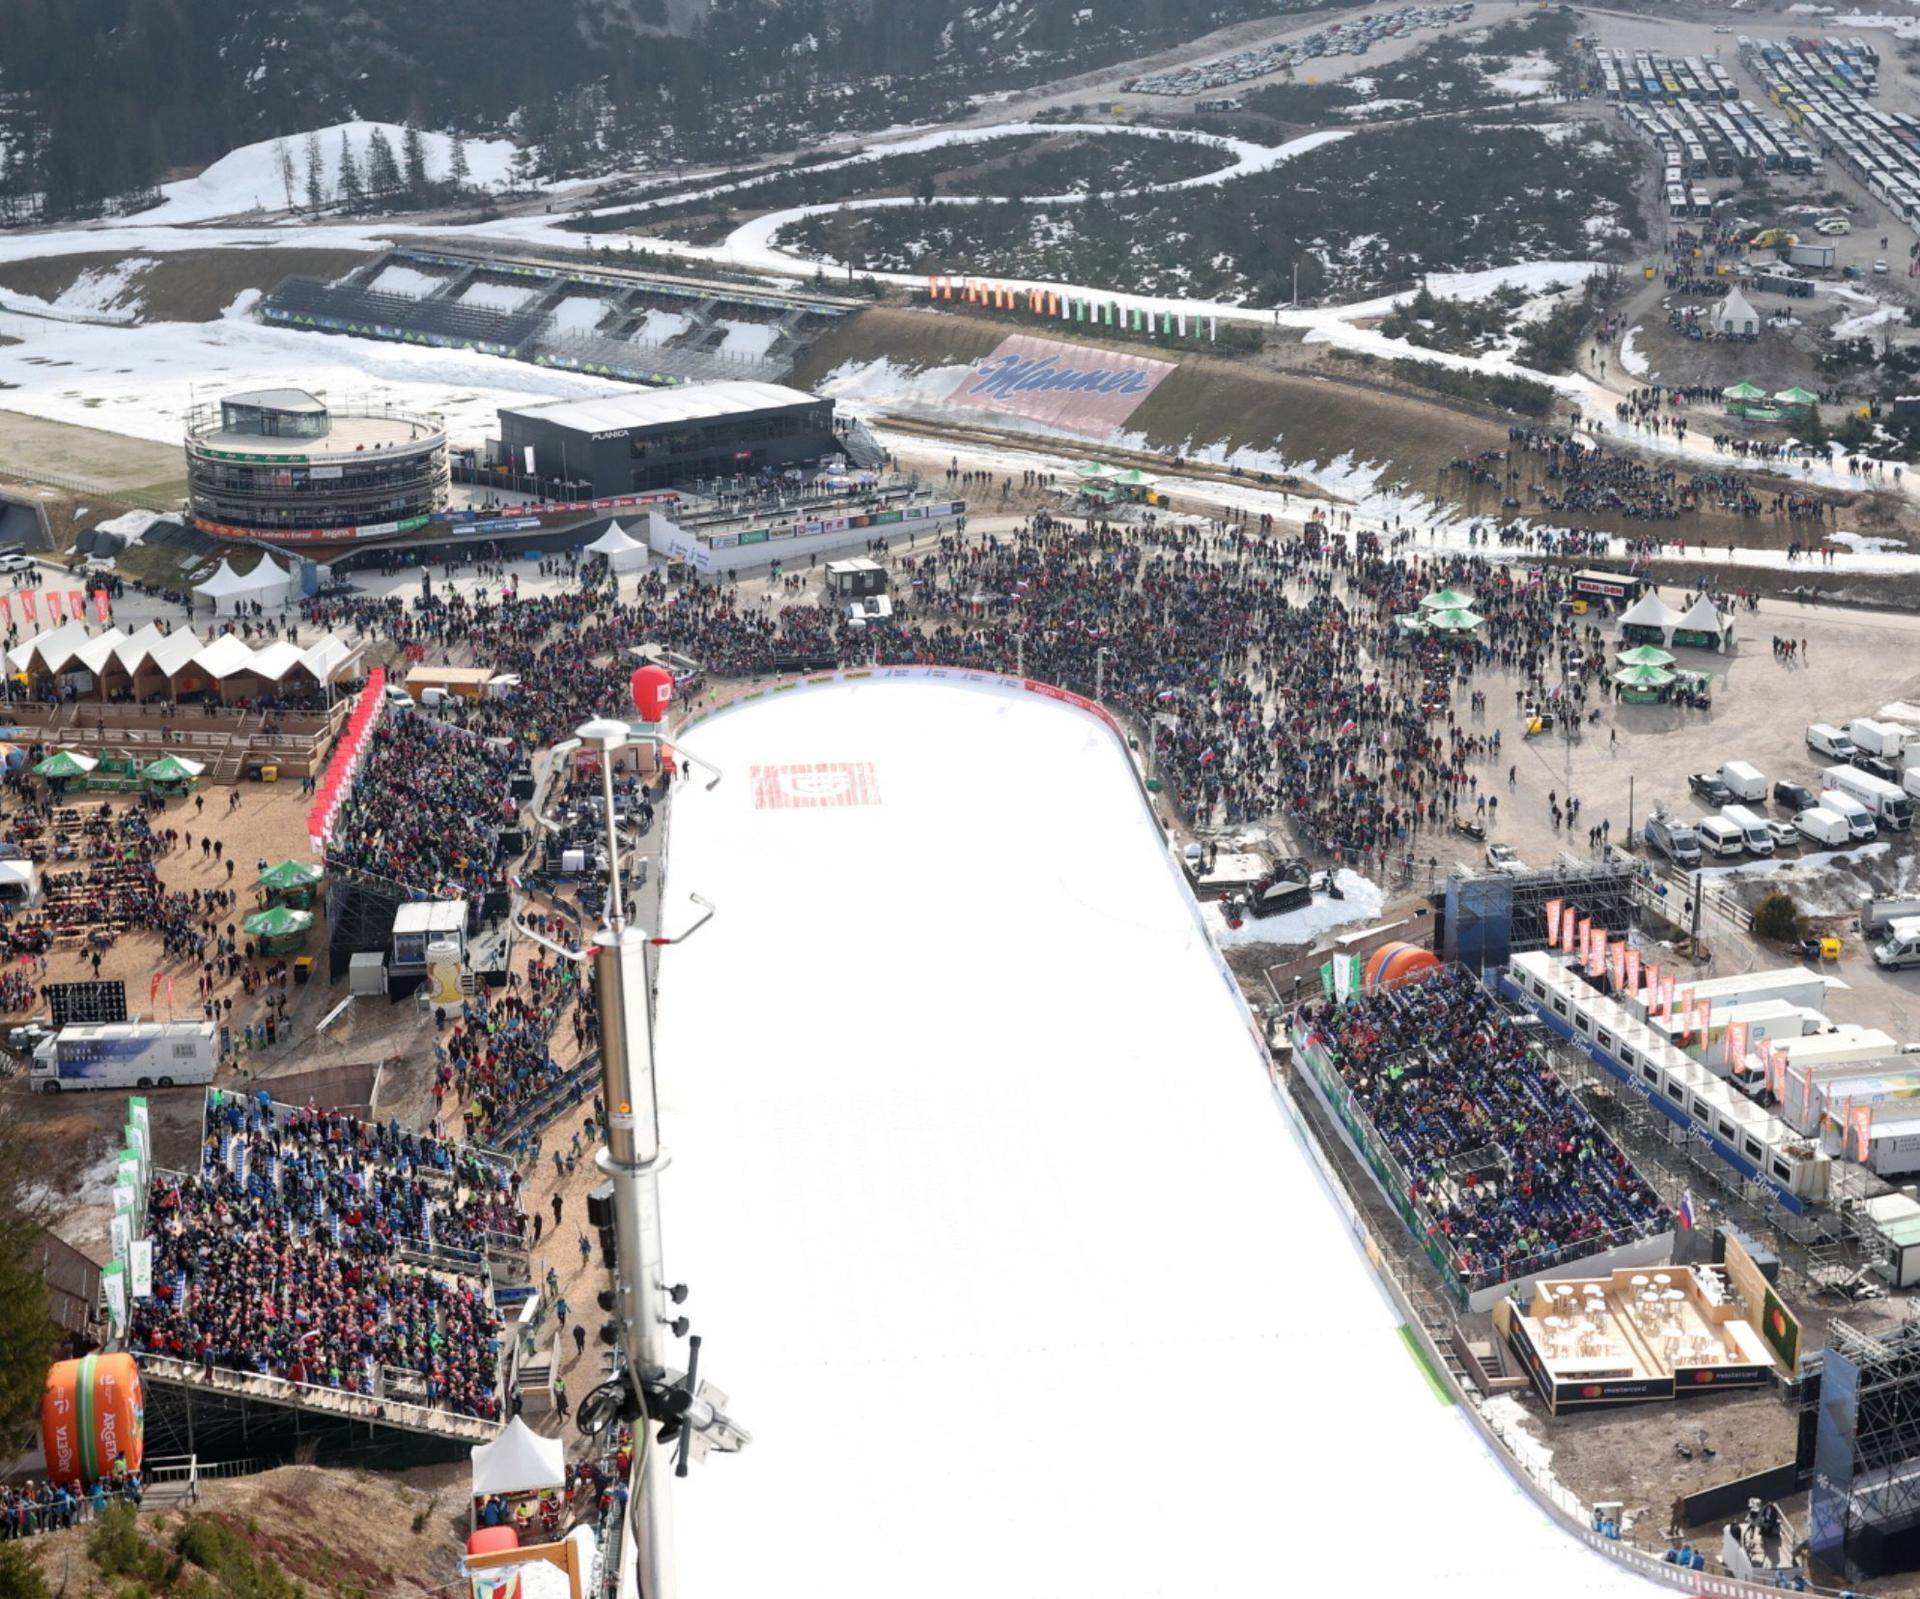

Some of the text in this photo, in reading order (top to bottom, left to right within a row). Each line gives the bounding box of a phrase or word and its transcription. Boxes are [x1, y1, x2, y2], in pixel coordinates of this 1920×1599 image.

[967, 352, 1152, 401] Manner
[592, 429, 630, 441] PLANICA
[1518, 992, 1540, 1016] Ford
[1570, 1031, 1595, 1057] Ford
[1626, 1074, 1650, 1102] Ford
[1687, 1120, 1714, 1149] Ford
[1752, 1171, 1781, 1201] Ford
[1715, 1368, 1759, 1380] mastercard
[56, 1425, 72, 1473] ARGETA
[101, 1412, 117, 1461] ARGETA
